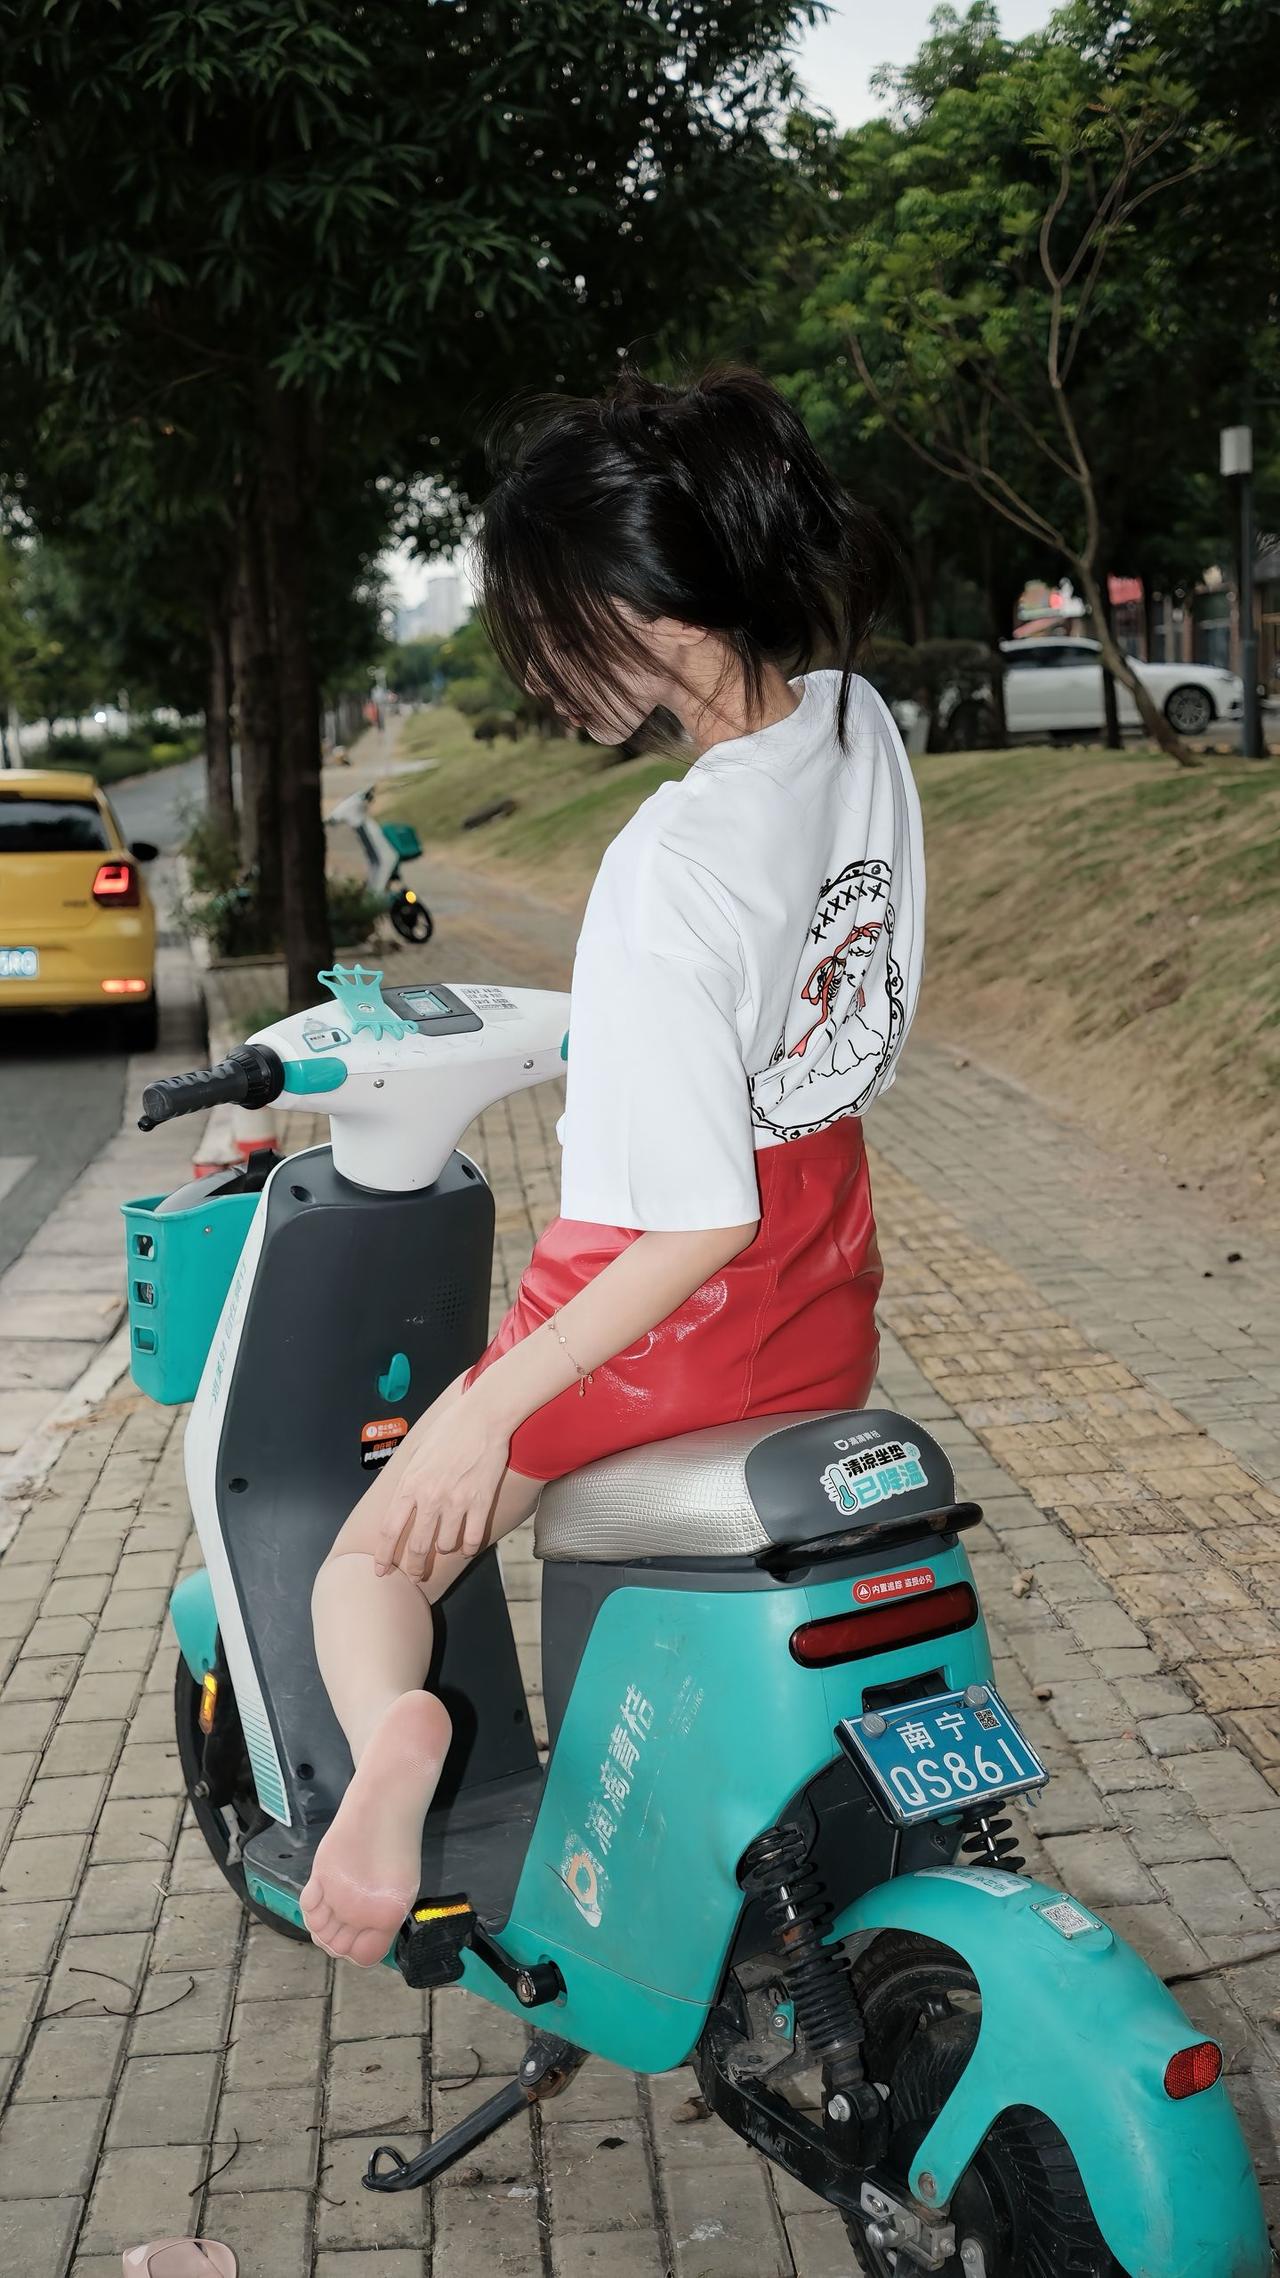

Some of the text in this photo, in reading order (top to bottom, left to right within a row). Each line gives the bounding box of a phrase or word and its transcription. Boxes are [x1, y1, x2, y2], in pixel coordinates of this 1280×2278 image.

[843, 1444, 907, 1478] 清凉坐垫
[896, 1711, 966, 1754] 南宁
[890, 1738, 1025, 1807] QS861
